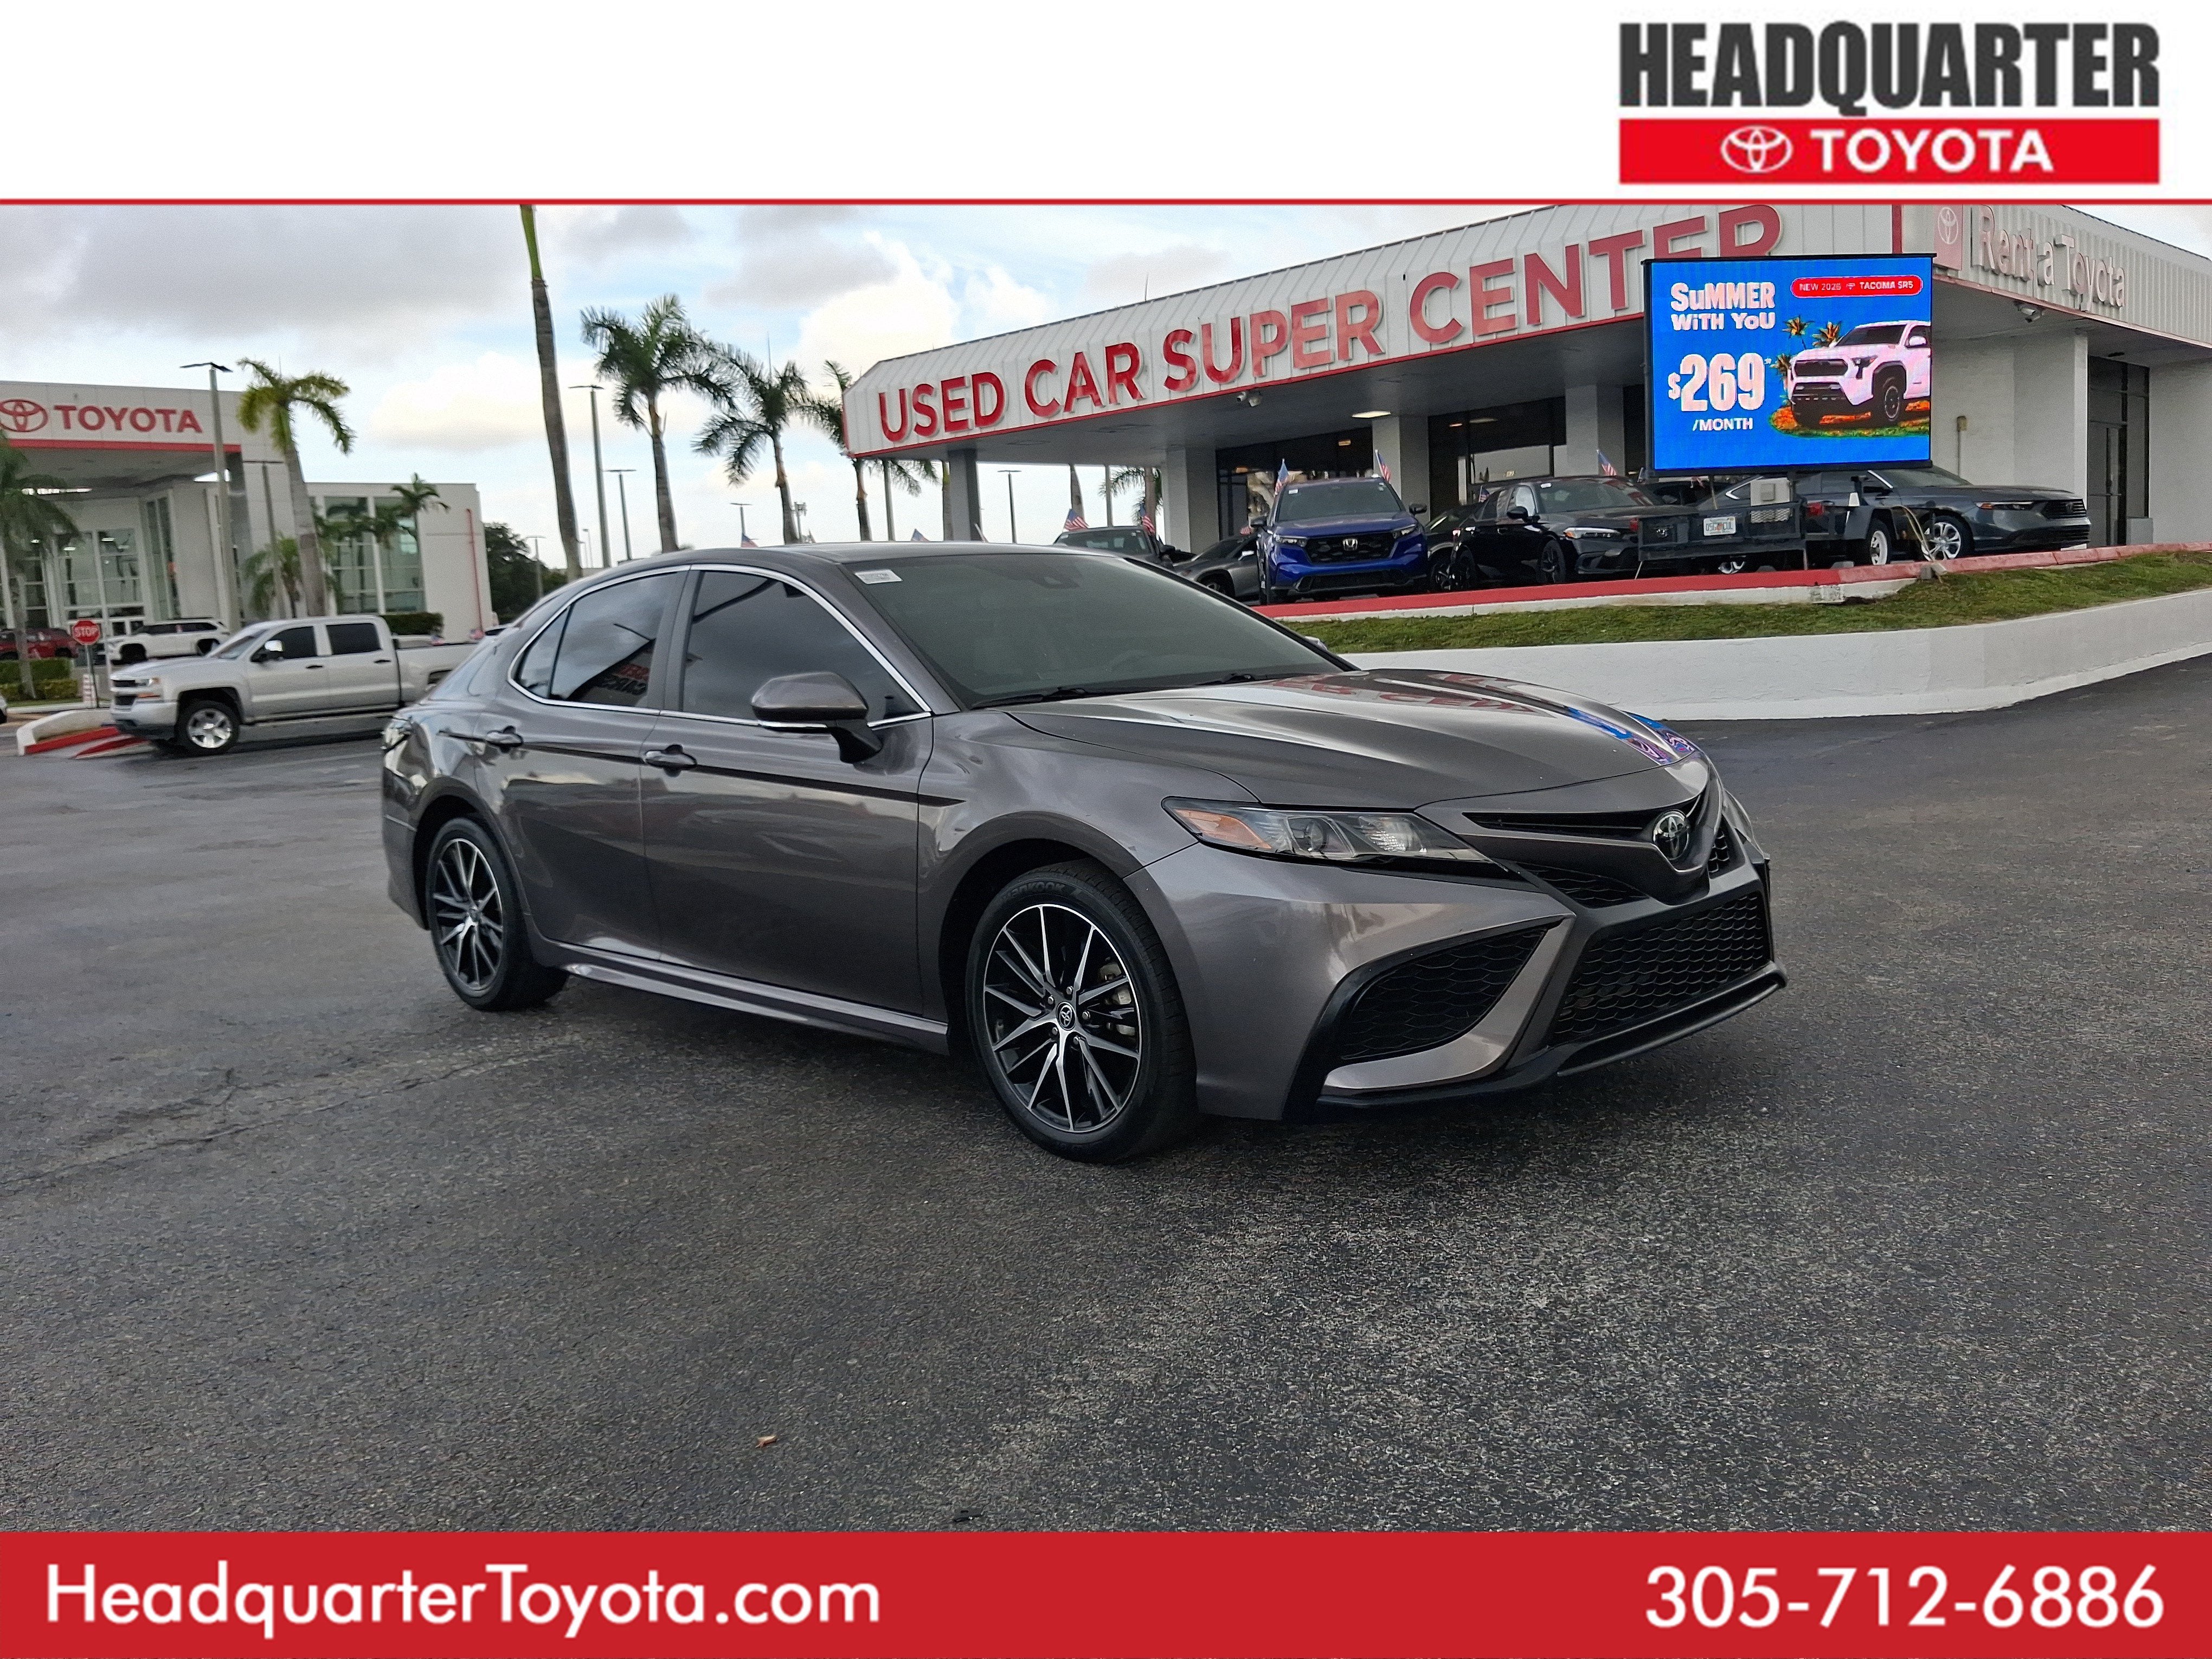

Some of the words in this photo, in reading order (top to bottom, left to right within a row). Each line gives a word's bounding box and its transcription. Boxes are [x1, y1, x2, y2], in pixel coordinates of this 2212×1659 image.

[1972, 204, 2034, 282] Rent
[2037, 241, 2055, 287] a
[2054, 234, 2126, 312] Toyota
[1799, 282, 1819, 291] NEW
[1859, 280, 1896, 290] TACOMA
[1897, 280, 1914, 289] SR5
[879, 372, 1006, 442] USED
[1025, 343, 1143, 417] CAR
[1163, 291, 1382, 391] SUPER
[54, 405, 203, 433] TOYOTA
[75, 626, 98, 637] STOP
